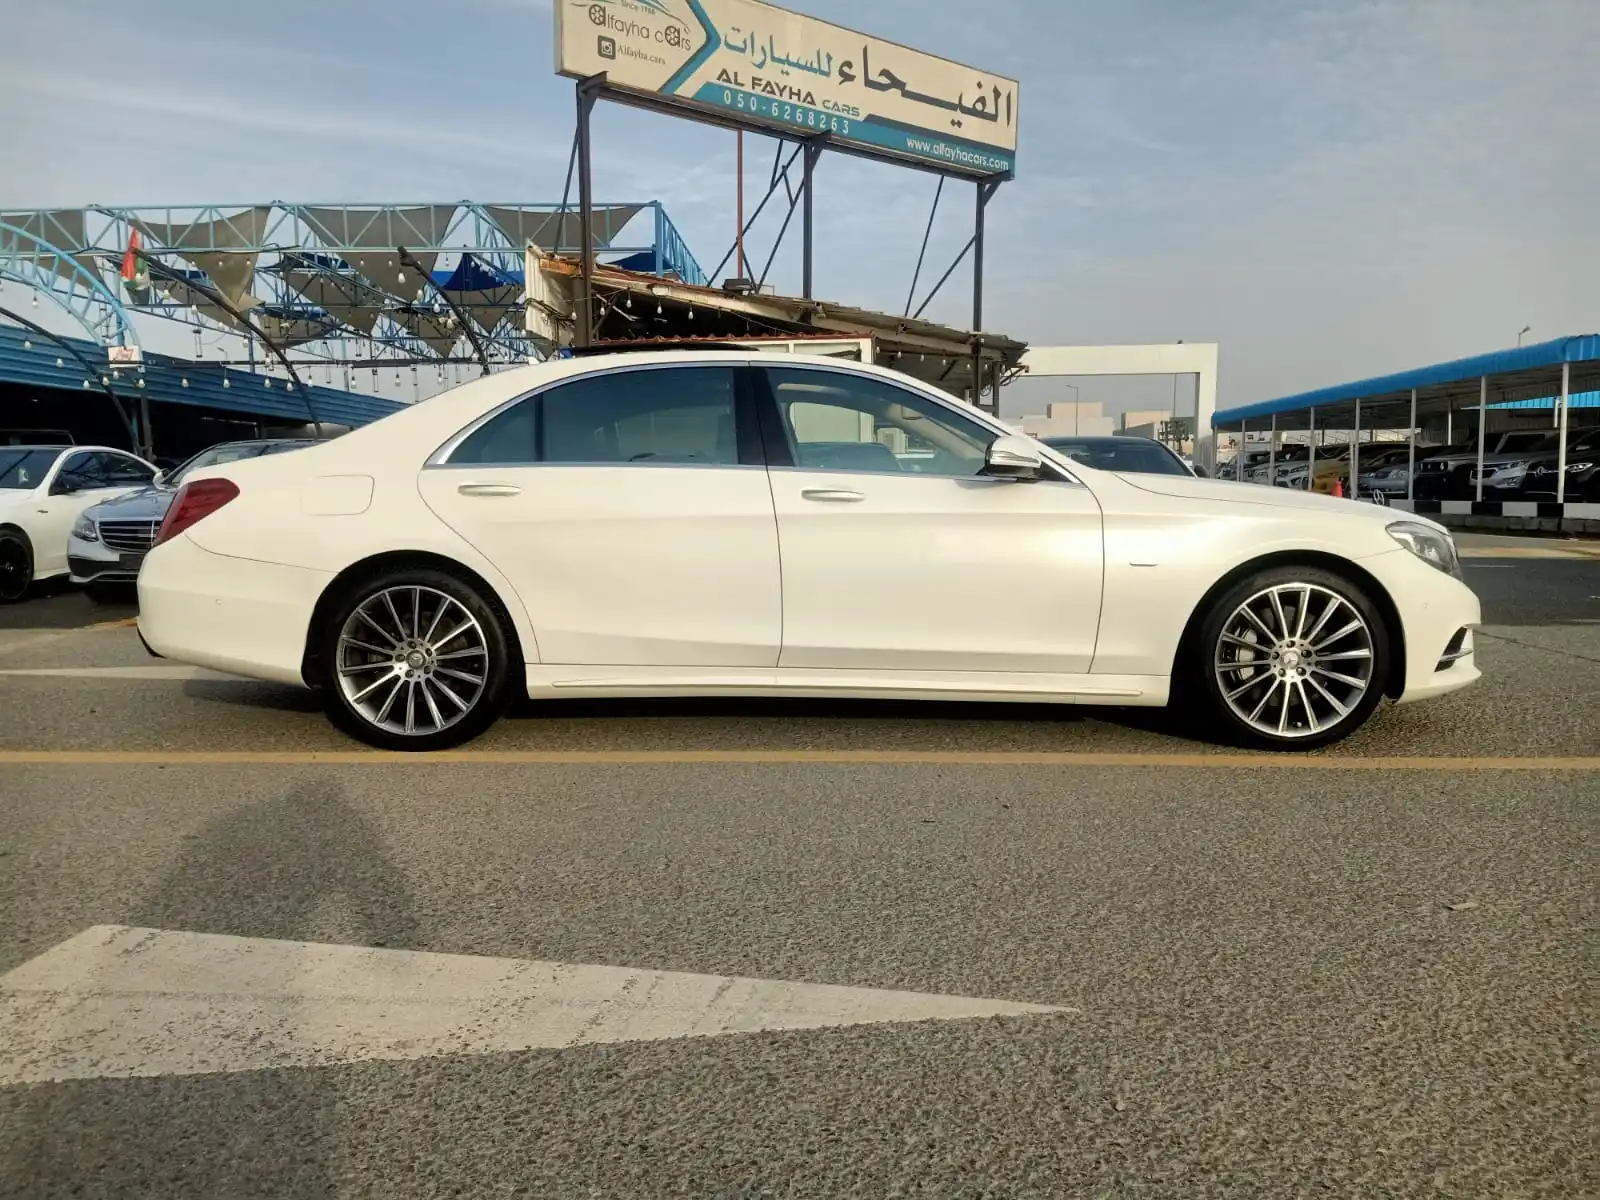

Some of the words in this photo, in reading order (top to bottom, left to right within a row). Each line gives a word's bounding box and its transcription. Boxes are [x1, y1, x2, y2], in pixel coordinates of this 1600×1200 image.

[588, 4, 650, 39] alfayha
[655, 25, 692, 51] cars
[724, 26, 833, 78] للسيارات
[716, 68, 745, 87] AL
[751, 76, 817, 106] FAYHA
[822, 99, 860, 117] CARS
[838, 44, 1012, 128] الفيحاء
[724, 90, 849, 134] 050-6268263
[906, 137, 1009, 171] www.alfayhacars.com
